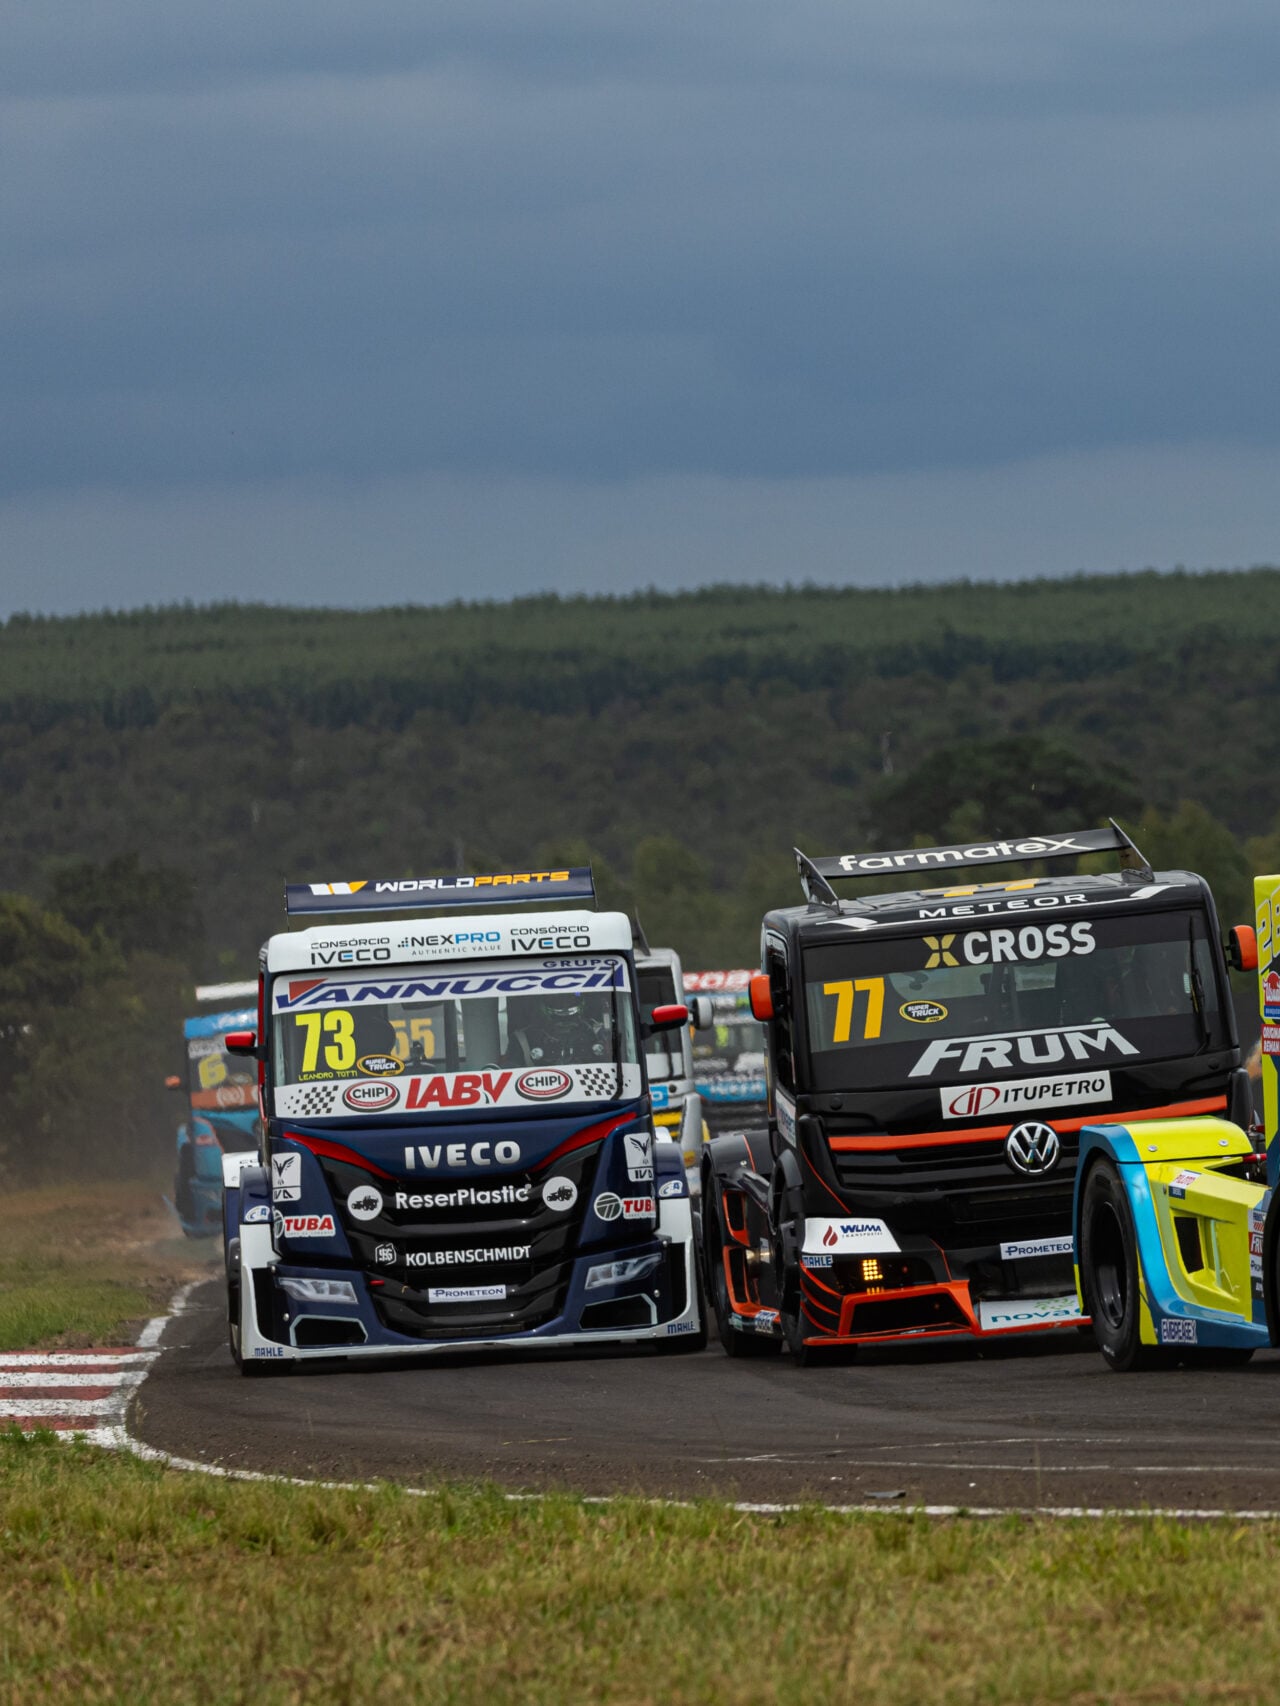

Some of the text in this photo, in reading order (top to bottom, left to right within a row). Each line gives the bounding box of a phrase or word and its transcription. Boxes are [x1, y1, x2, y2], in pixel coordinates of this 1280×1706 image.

[919, 893, 1088, 919] METEOR
[509, 925, 590, 937] CONSÓRCIO
[310, 937, 391, 950] CONSÓRCIO
[411, 931, 501, 947] NEXPRO
[511, 935, 591, 952] IVECO
[310, 947, 391, 965] IVECO
[411, 943, 502, 957] AUTHENTIC VALUE
[543, 959, 619, 969] GRUPO
[823, 977, 885, 1043] 77
[906, 1003, 930, 1013] SUPER
[911, 1007, 940, 1018] TRUCK
[295, 1009, 356, 1073] 73
[907, 1022, 1141, 1078] FRUM
[369, 1061, 397, 1073] TRUCK
[524, 1074, 562, 1088] CHIPI
[352, 1086, 390, 1100] CHIPI
[1003, 1077, 1105, 1104] ITUPETRO
[404, 1140, 521, 1170] IVECO
[284, 1216, 334, 1231] TUBA
[405, 1245, 532, 1267] KOLBENSCHMIDT
[433, 1287, 505, 1299] PROMETEON
[667, 1320, 695, 1335] MAHLE
[254, 1347, 284, 1358] MAHLE
